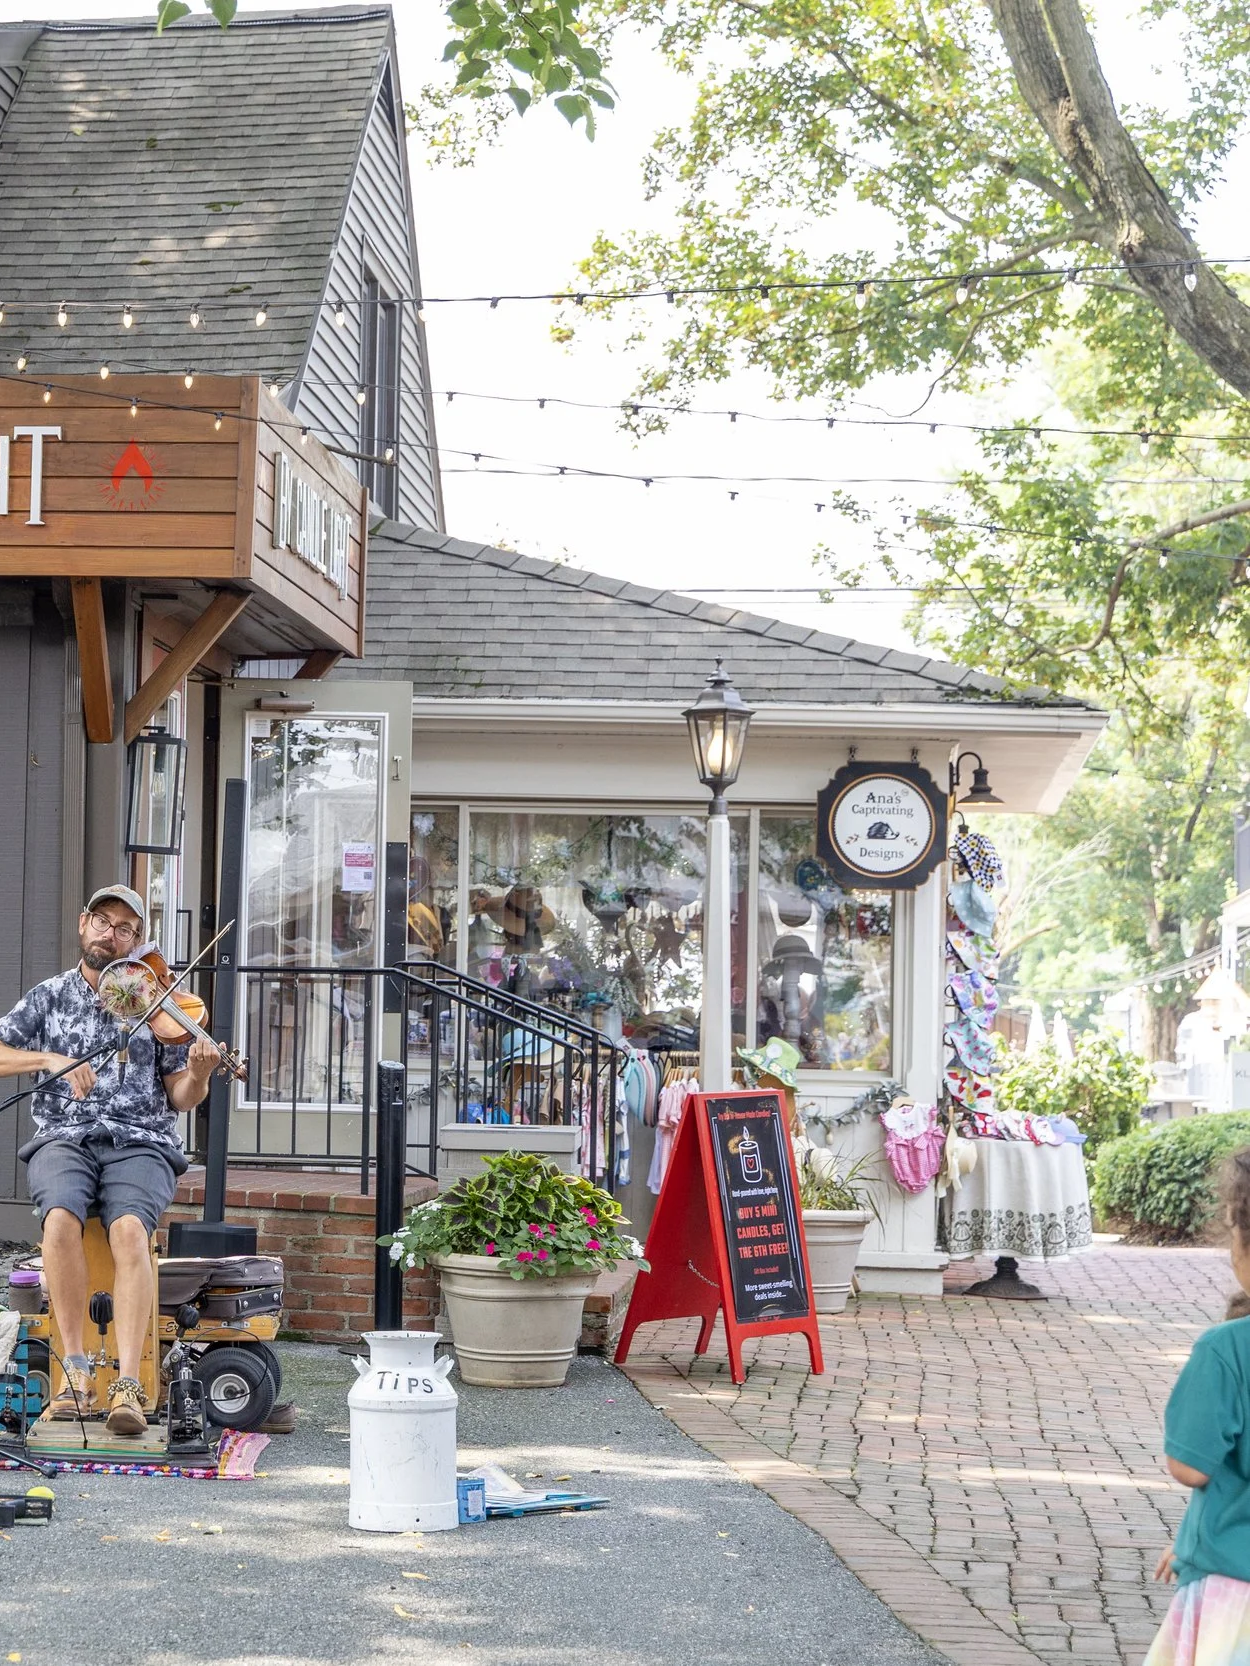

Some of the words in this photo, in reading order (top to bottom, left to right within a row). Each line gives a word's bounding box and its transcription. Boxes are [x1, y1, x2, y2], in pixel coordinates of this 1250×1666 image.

[865, 791, 902, 804] Ana's
[851, 804, 915, 819] Captivating
[859, 847, 905, 861] Designs
[738, 1206, 753, 1220] BUY
[755, 1206, 761, 1218] 5
[761, 1204, 778, 1217] MINI
[736, 1224, 771, 1240] CANDLES,
[772, 1223, 785, 1236] GET
[738, 1244, 753, 1259] THE
[753, 1243, 768, 1257] 6TH
[769, 1242, 789, 1255] FREE!
[745, 1283, 758, 1292] More
[758, 1279, 794, 1290] sweet-smelling
[754, 1291, 767, 1301] deals
